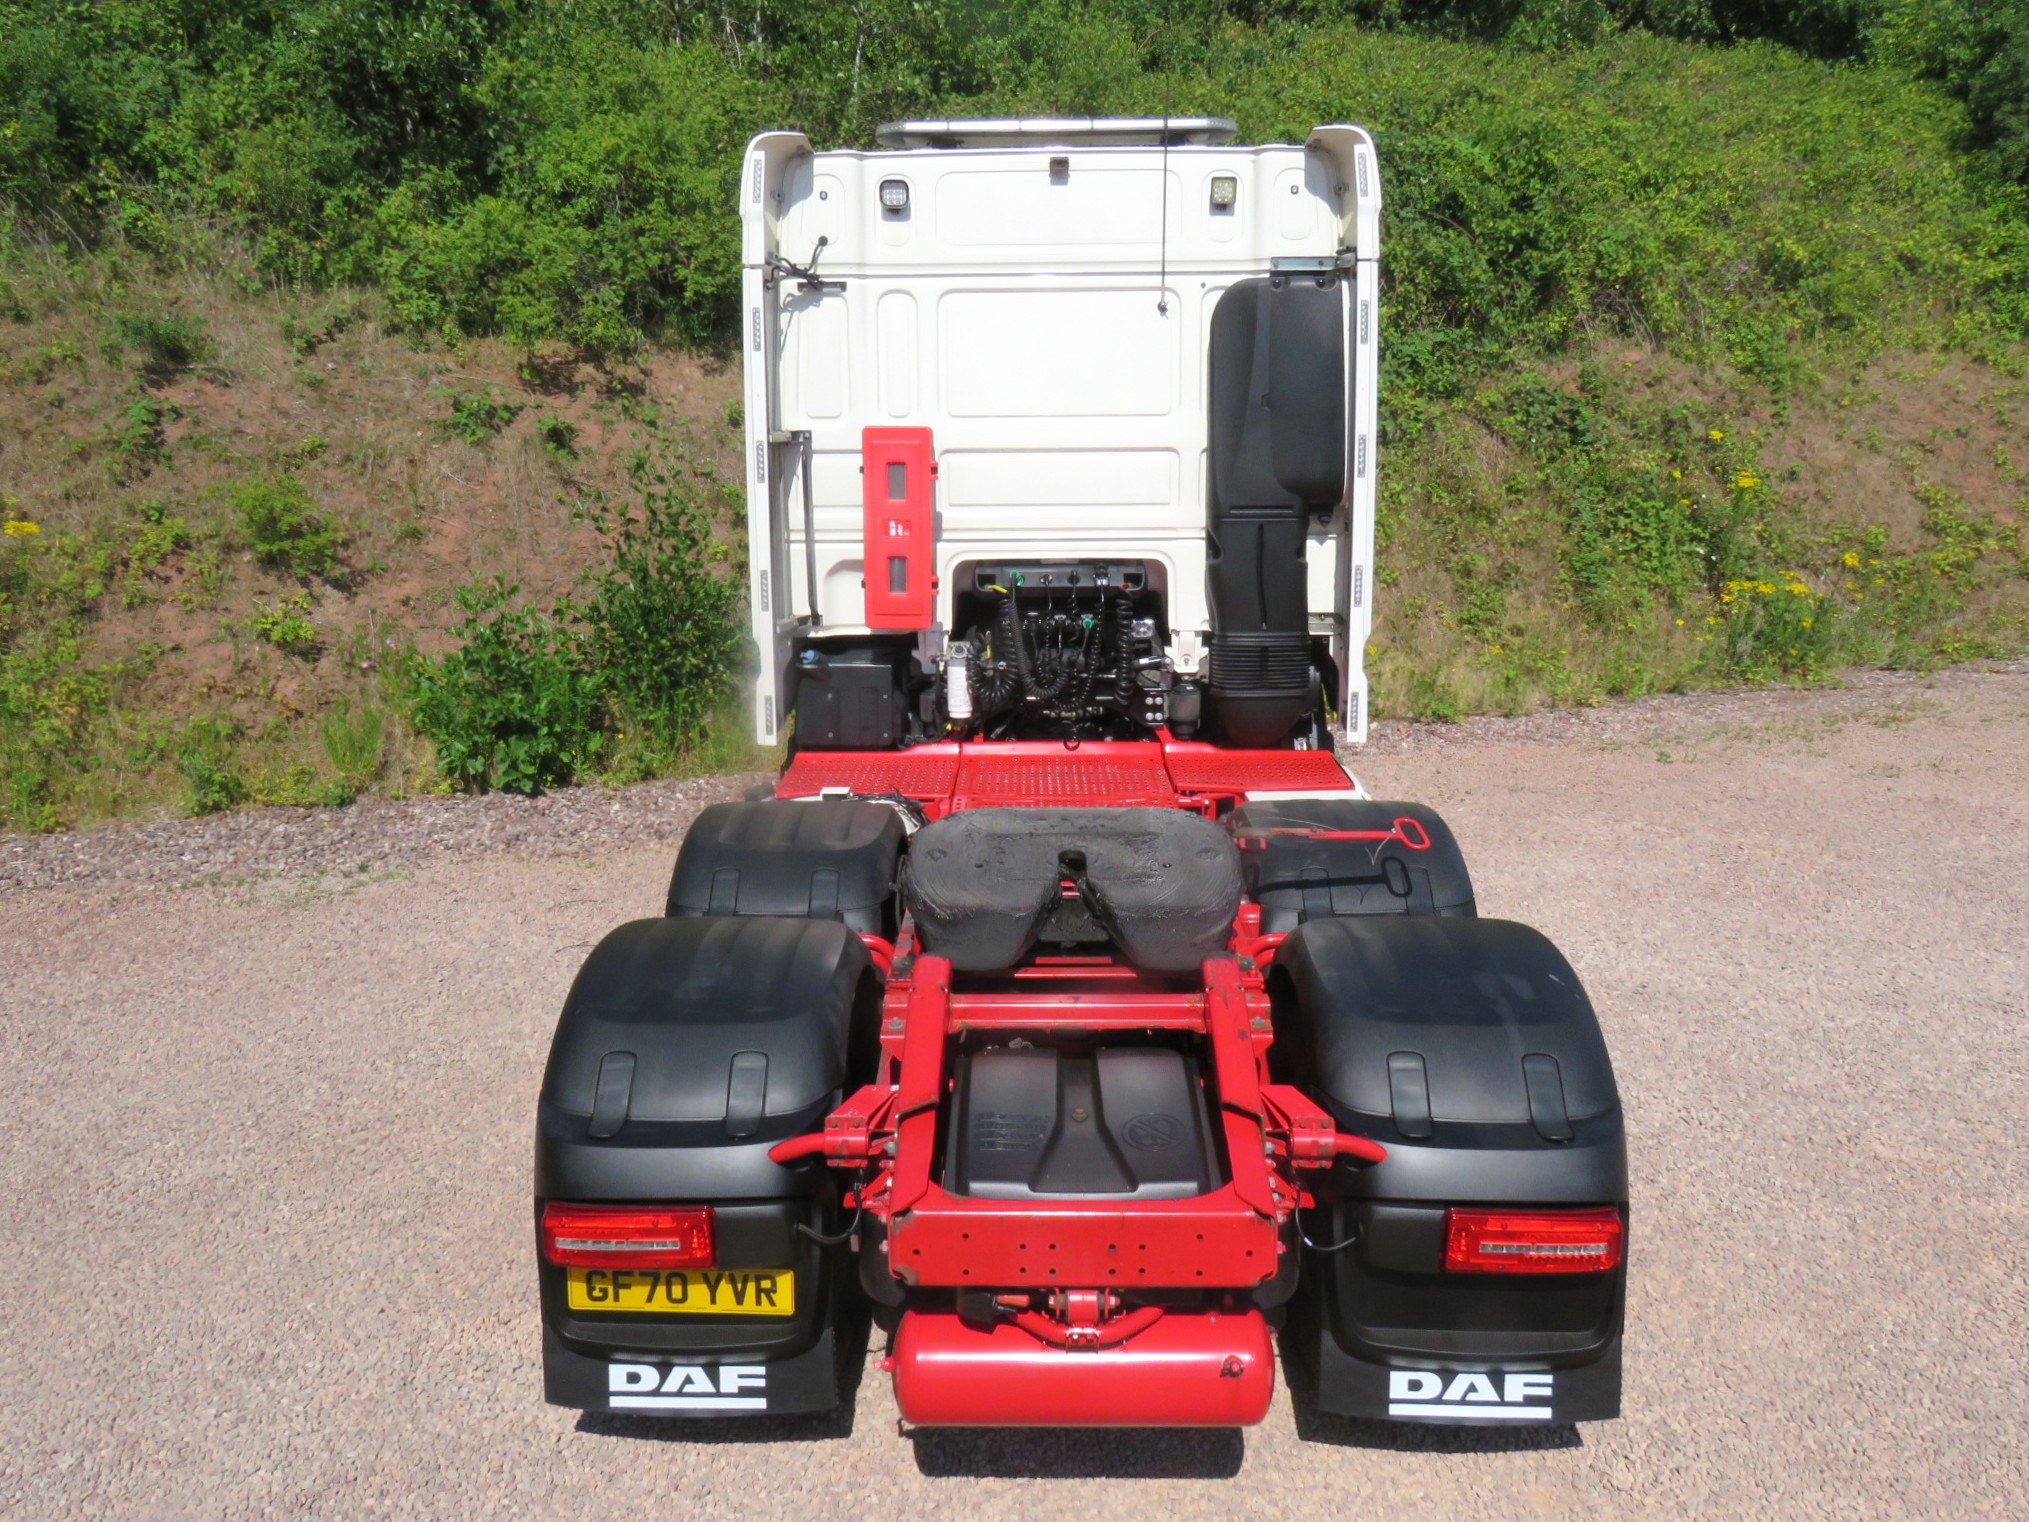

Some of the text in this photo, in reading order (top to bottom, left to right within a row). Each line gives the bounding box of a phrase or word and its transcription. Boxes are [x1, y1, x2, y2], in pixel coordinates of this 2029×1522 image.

[585, 1270, 777, 1307] GF70 YVR
[608, 1364, 766, 1393] DAF
[1389, 1371, 1553, 1402] DAF
